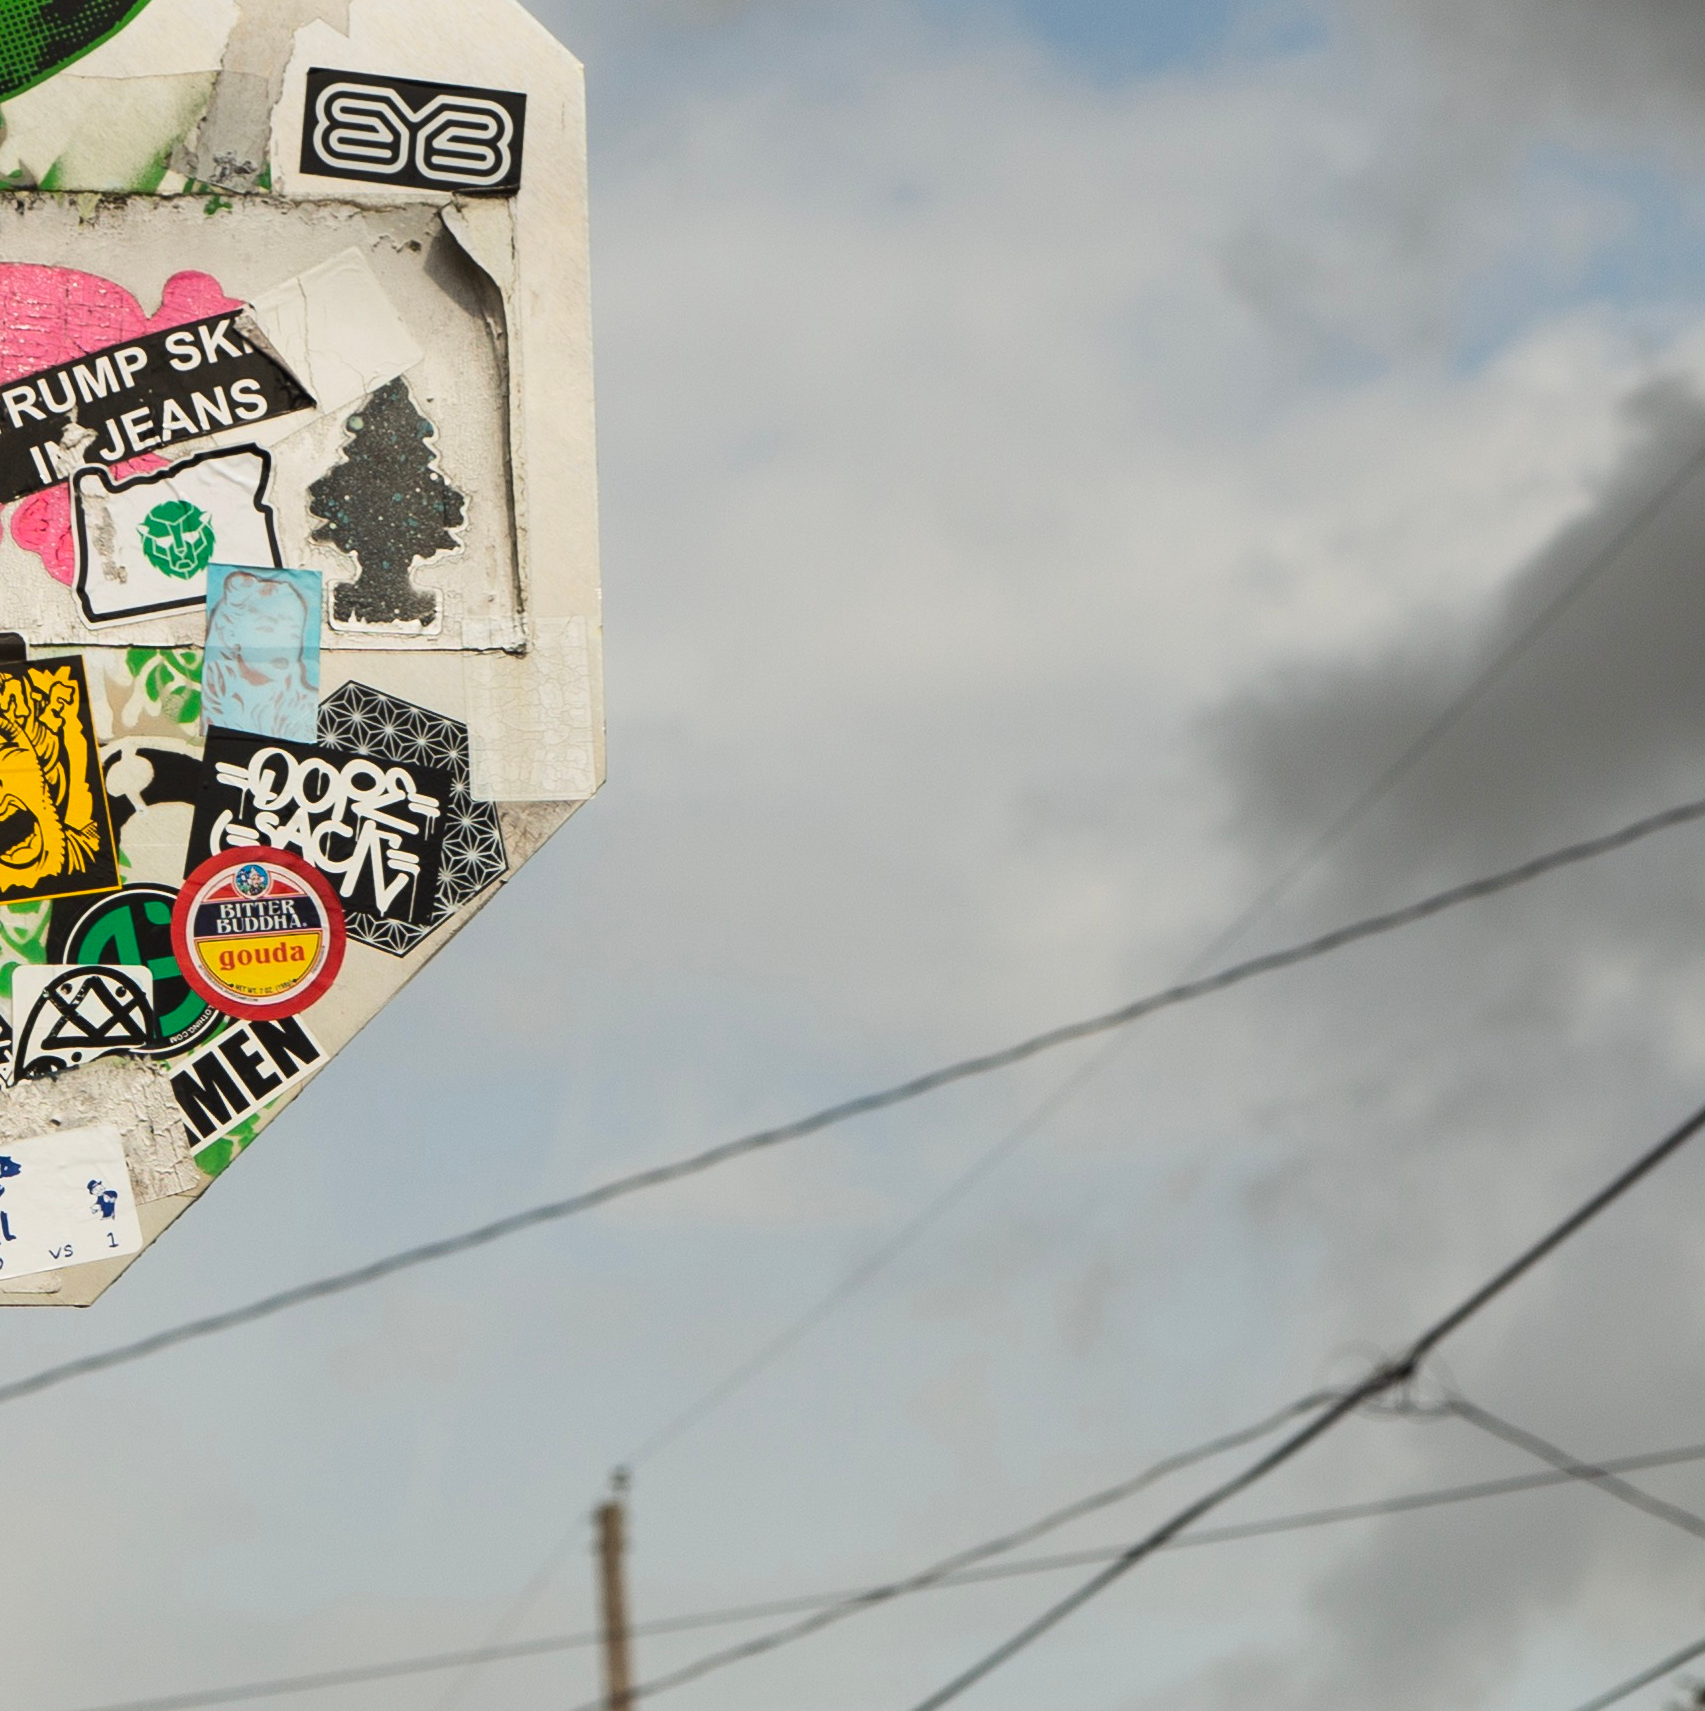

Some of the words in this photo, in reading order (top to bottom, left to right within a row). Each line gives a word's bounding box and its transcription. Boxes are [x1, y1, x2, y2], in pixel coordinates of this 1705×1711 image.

[99, 377, 268, 462] JEANS
[220, 899, 295, 919] BITTER
[219, 942, 305, 971] gouda
[169, 1004, 216, 1044] LOTHING.COM
[169, 1014, 321, 1148] MEN
[106, 1231, 119, 1249] 1
